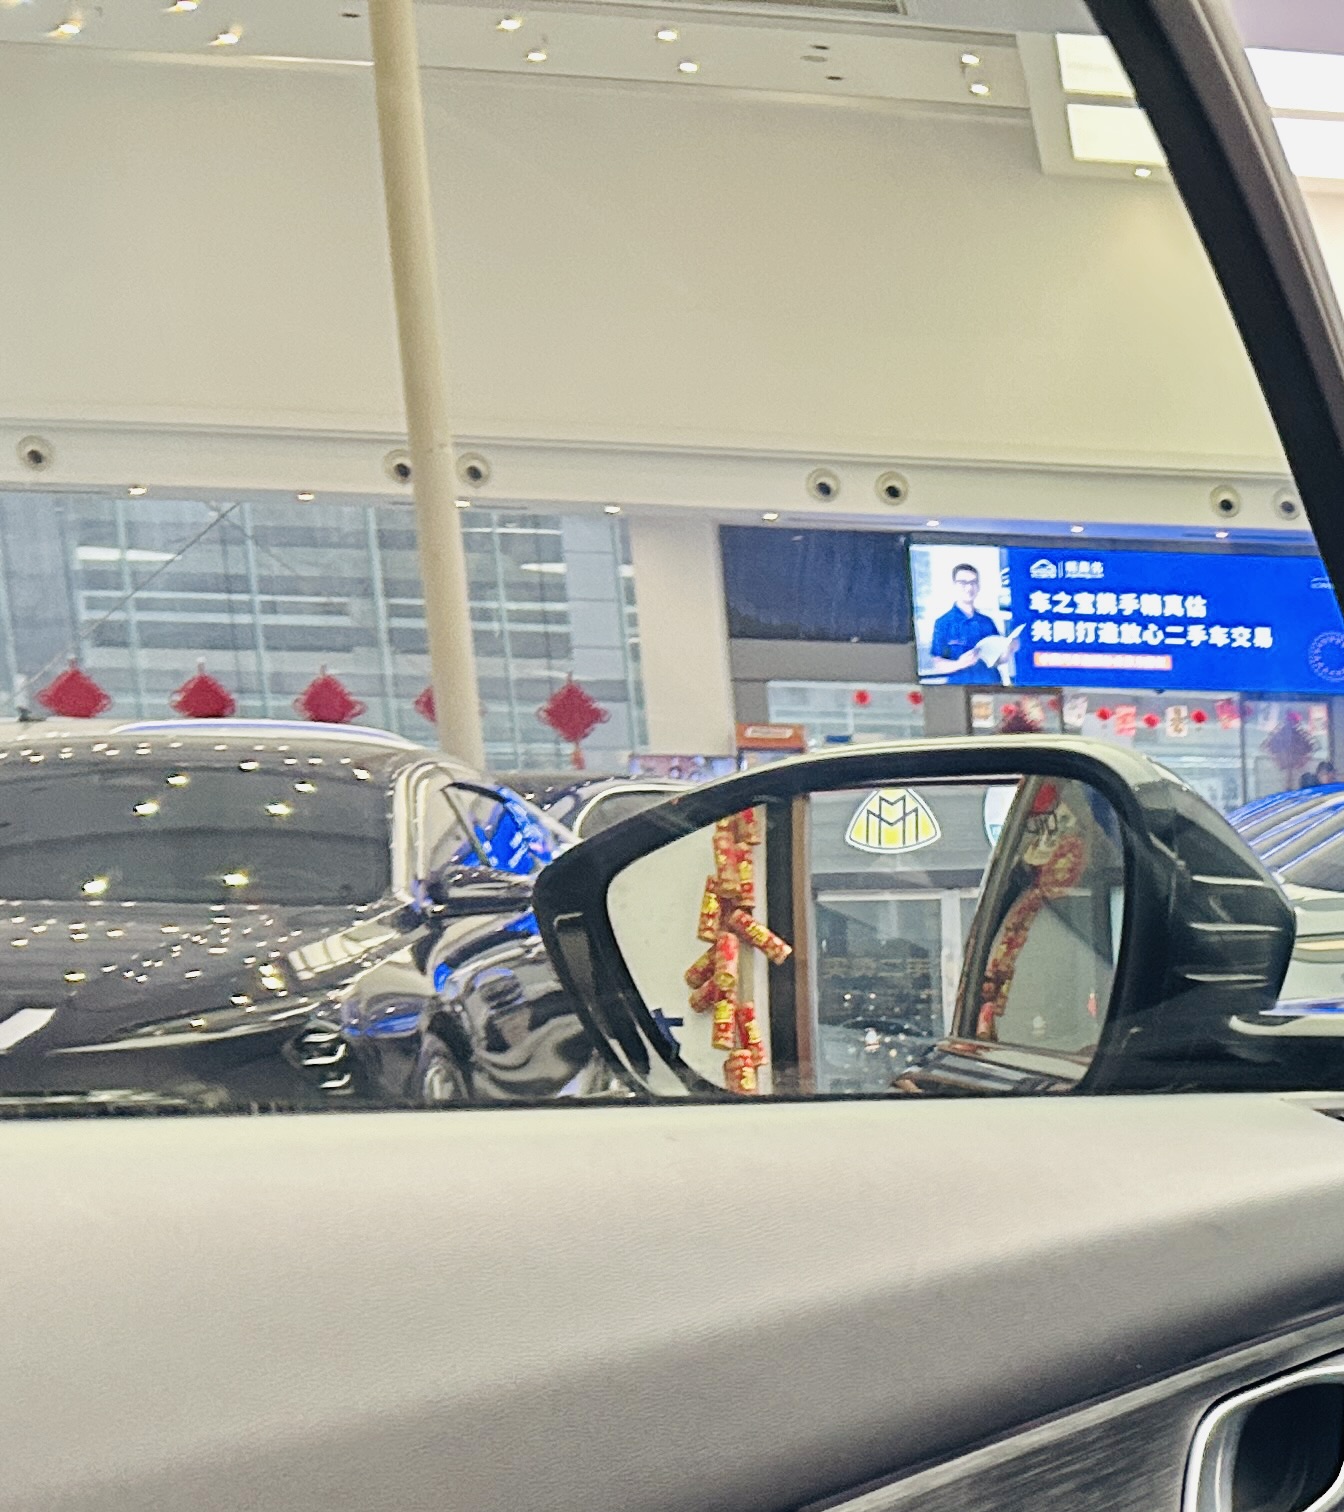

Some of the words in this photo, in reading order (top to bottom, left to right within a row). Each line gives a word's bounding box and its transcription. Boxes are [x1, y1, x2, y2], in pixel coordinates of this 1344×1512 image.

[1031, 619, 1273, 649] 共同打造放心二手车交易
